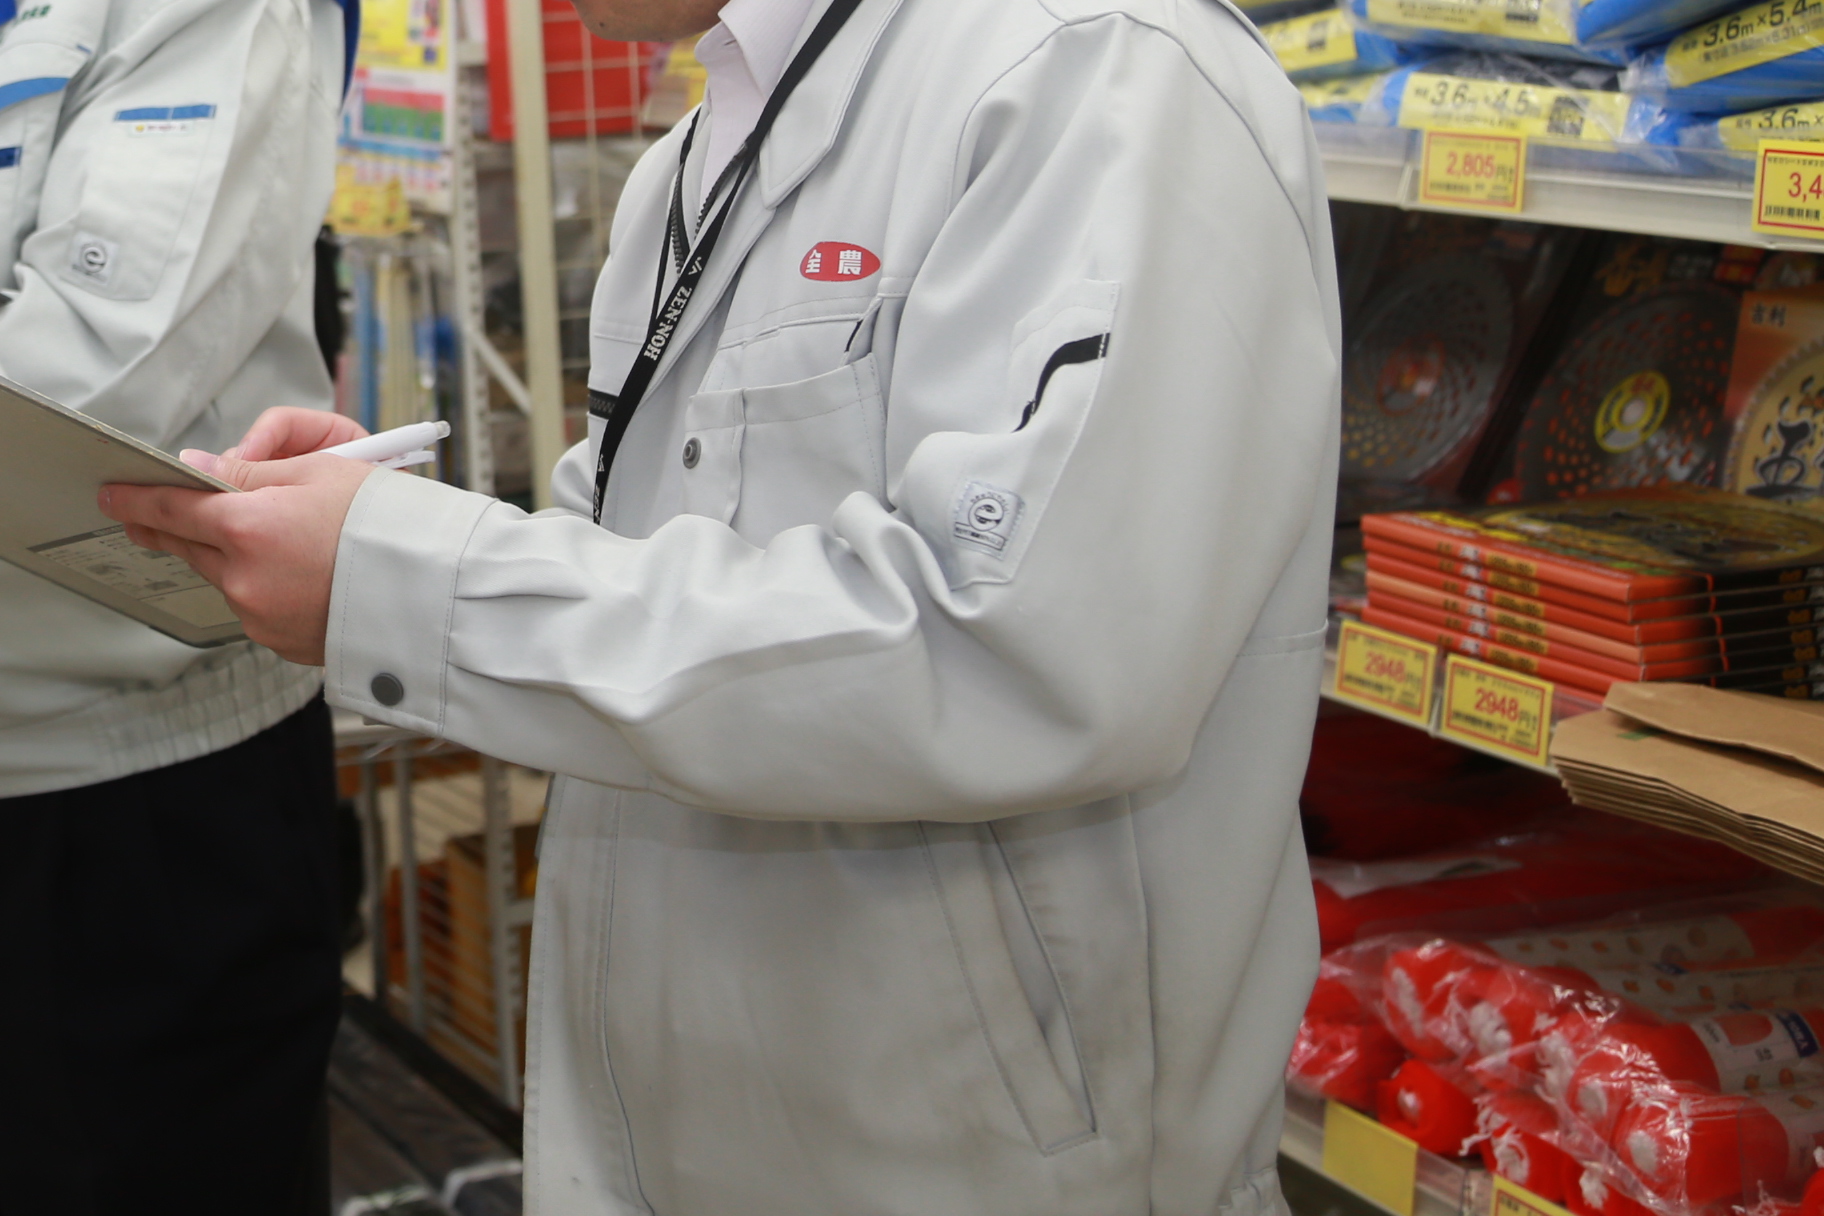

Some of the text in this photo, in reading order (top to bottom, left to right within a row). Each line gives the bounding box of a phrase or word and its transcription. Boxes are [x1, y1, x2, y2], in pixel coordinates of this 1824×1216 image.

[1788, 172, 1824, 203] 3,4
[805, 249, 862, 275] 全農
[643, 285, 693, 362] ZEN-NOH
